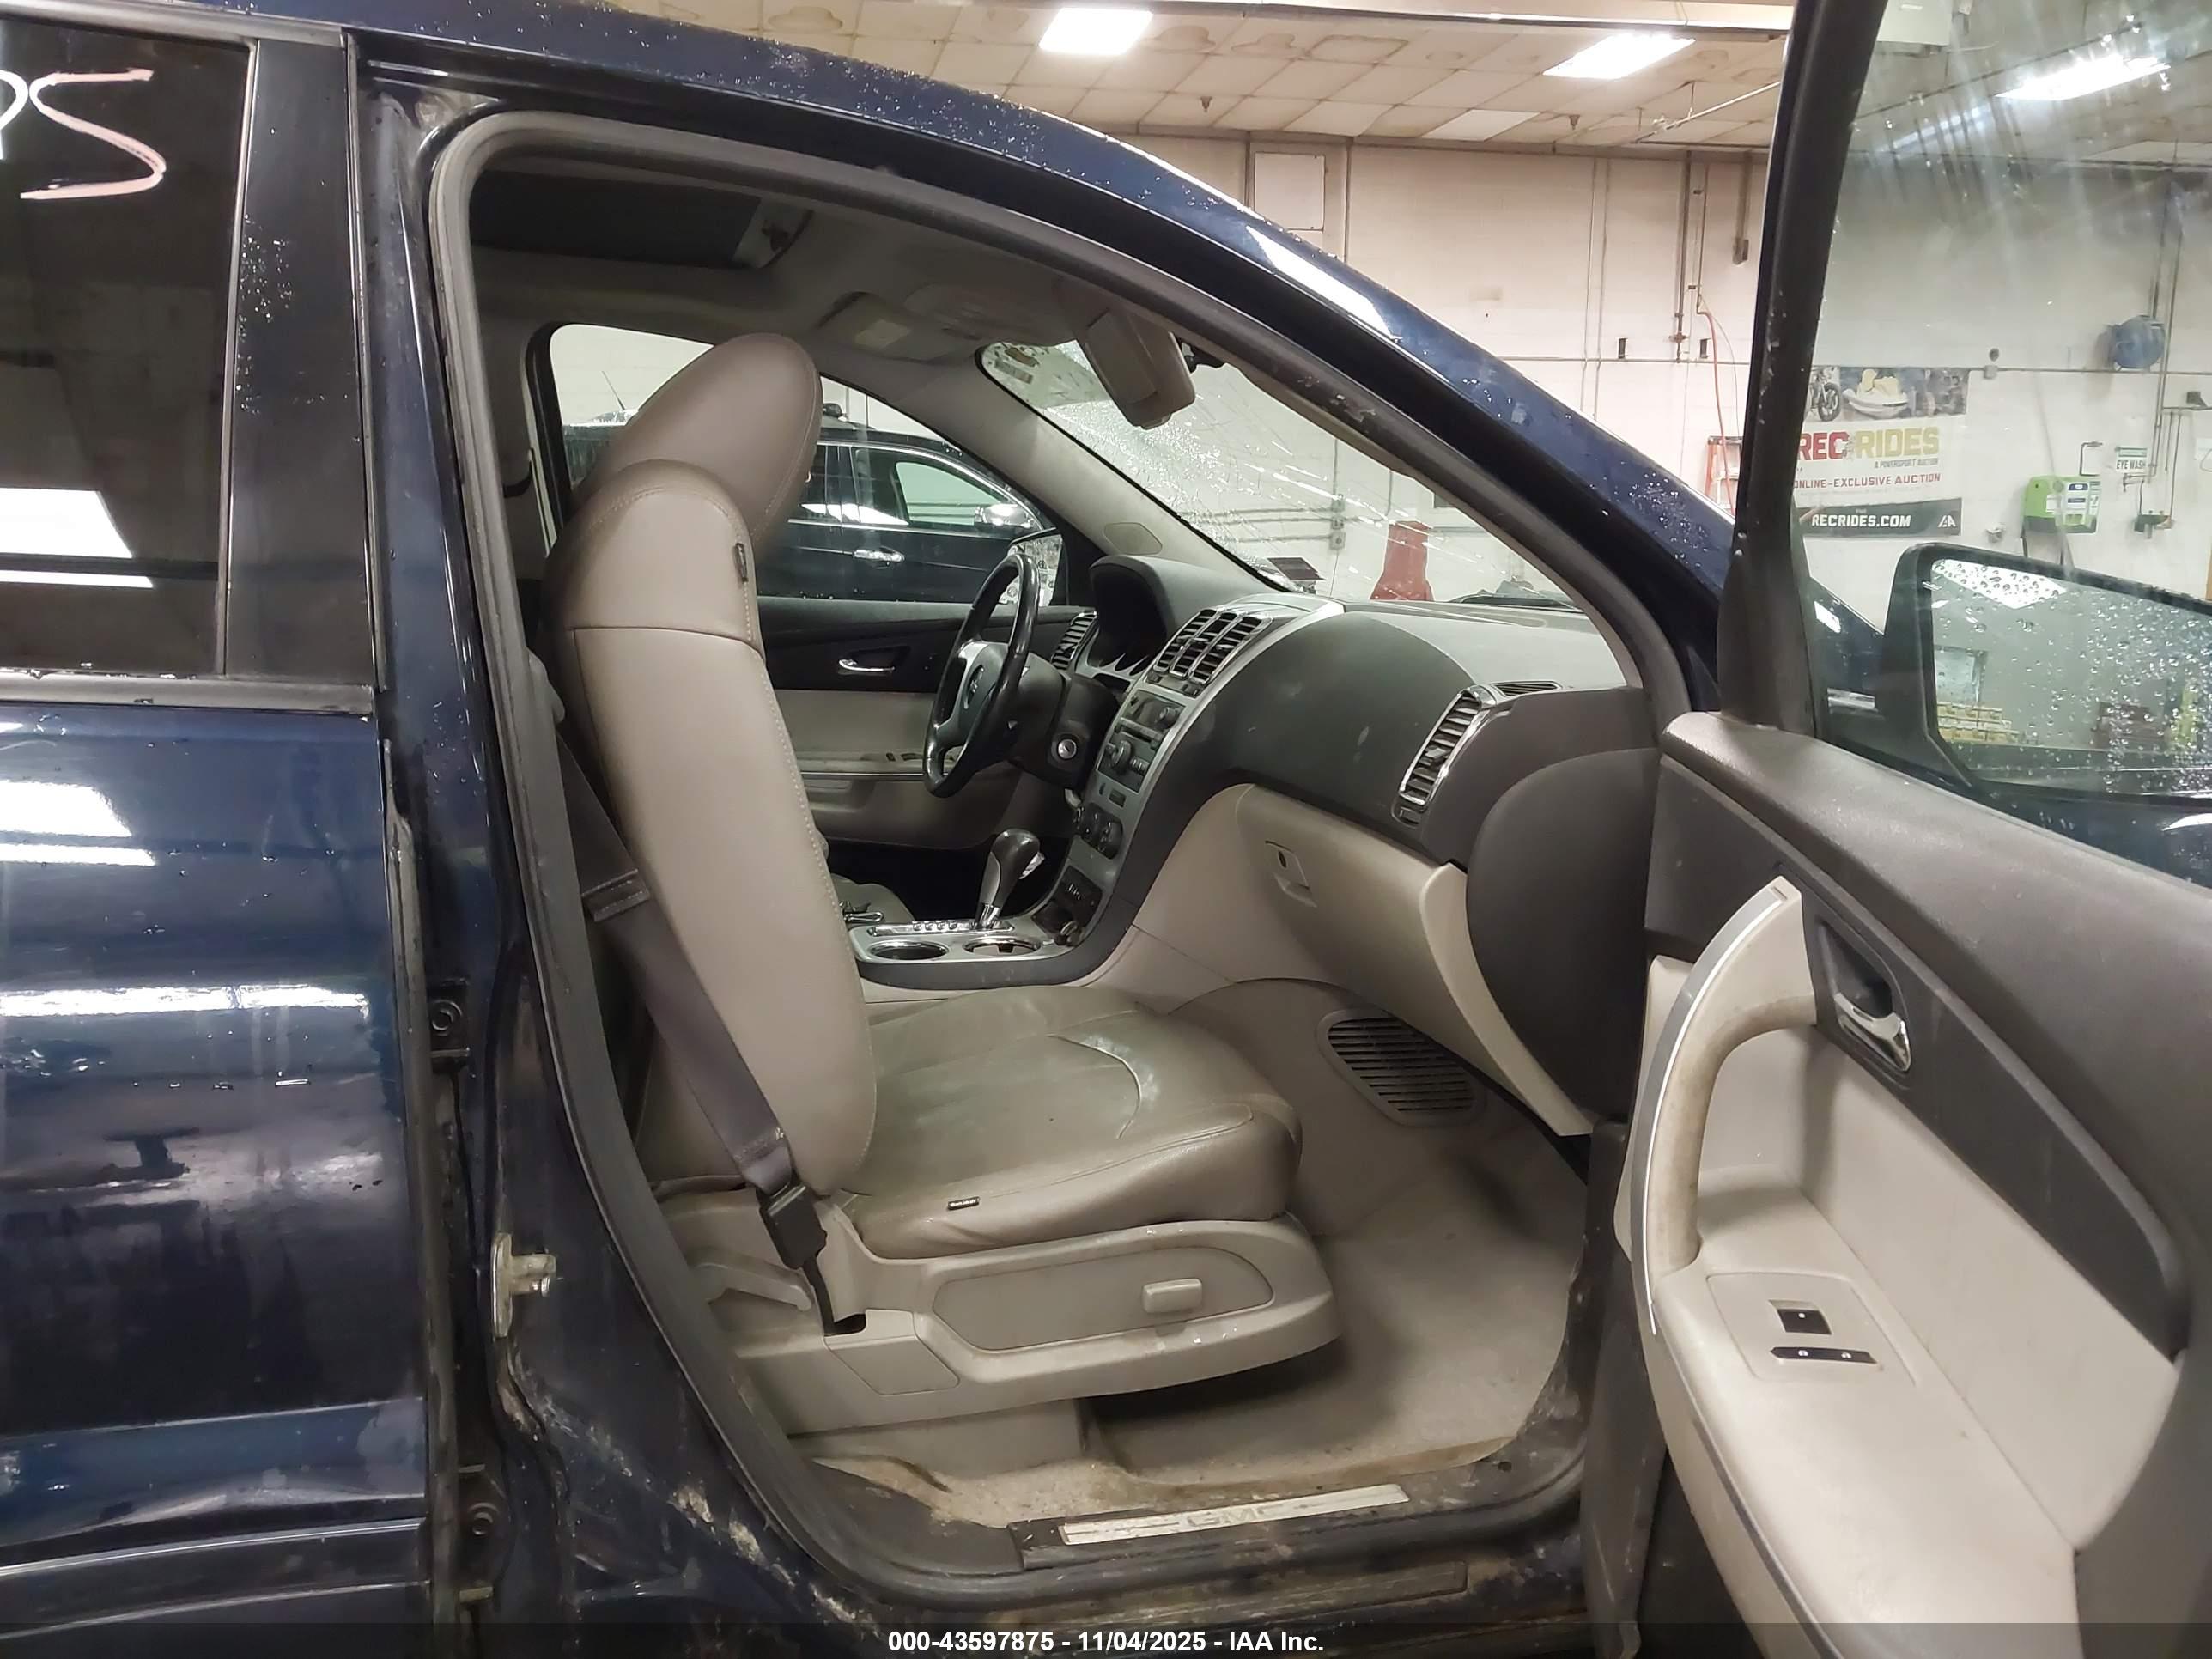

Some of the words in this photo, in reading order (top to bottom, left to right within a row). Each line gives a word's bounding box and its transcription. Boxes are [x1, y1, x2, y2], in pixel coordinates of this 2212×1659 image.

[1798, 431, 1849, 461] REC
[1855, 427, 1940, 459] RIDES
[2117, 459, 2128, 469] EYE
[1894, 472, 1941, 484] AUCTION
[1811, 514, 1911, 528] RECRIDES.COM
